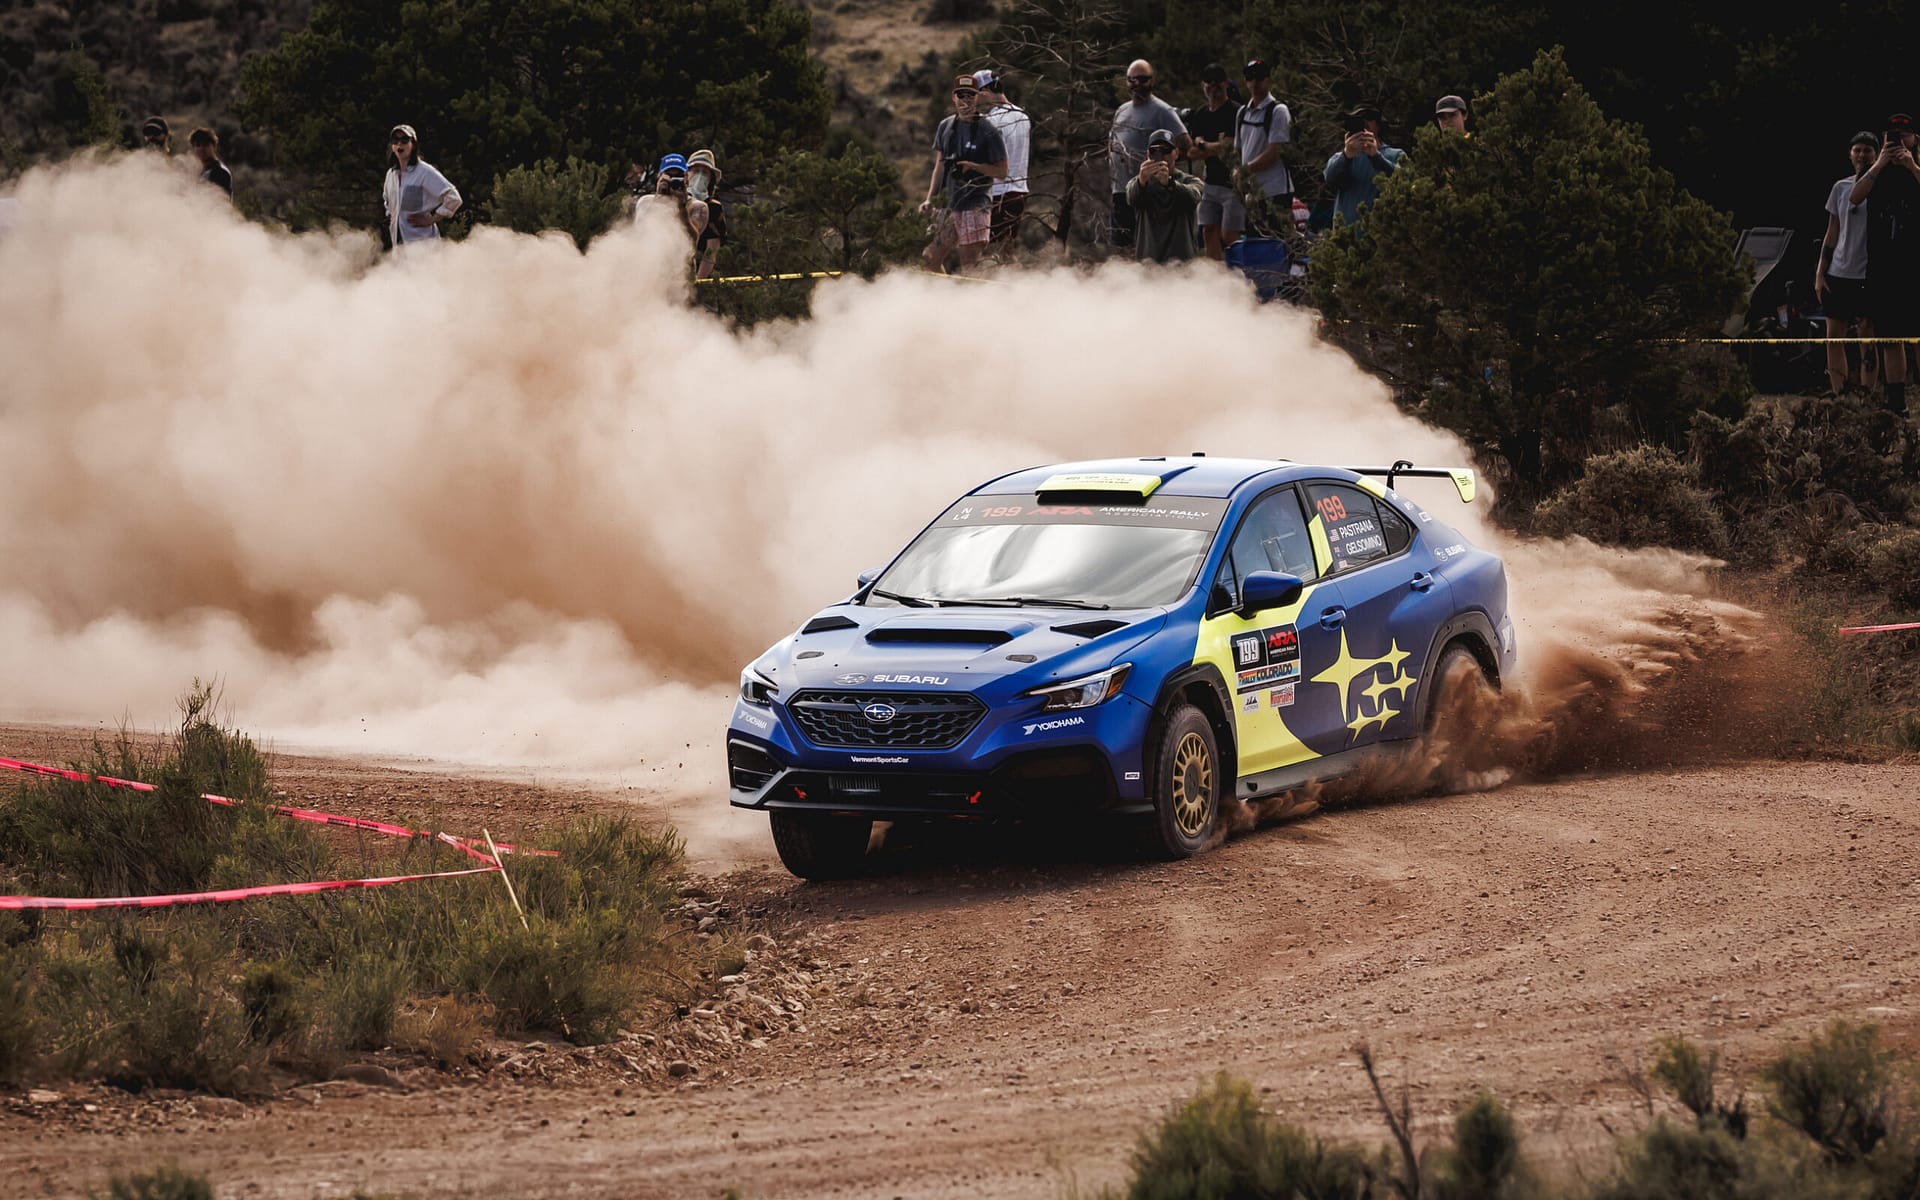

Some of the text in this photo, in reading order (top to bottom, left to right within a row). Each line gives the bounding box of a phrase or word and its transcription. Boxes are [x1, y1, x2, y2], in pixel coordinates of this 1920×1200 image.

[981, 506, 1023, 517] 199
[1169, 509, 1209, 517] RALLY
[1317, 495, 1347, 522] 199
[1339, 519, 1375, 538] PASTRANA
[1346, 535, 1382, 555] GELSOMINO
[1268, 631, 1297, 648] ARA
[1236, 637, 1259, 665] 199
[872, 674, 949, 685] SUBARU
[1256, 663, 1293, 681] COLORADO
[1037, 716, 1085, 731] YOKOHAMA
